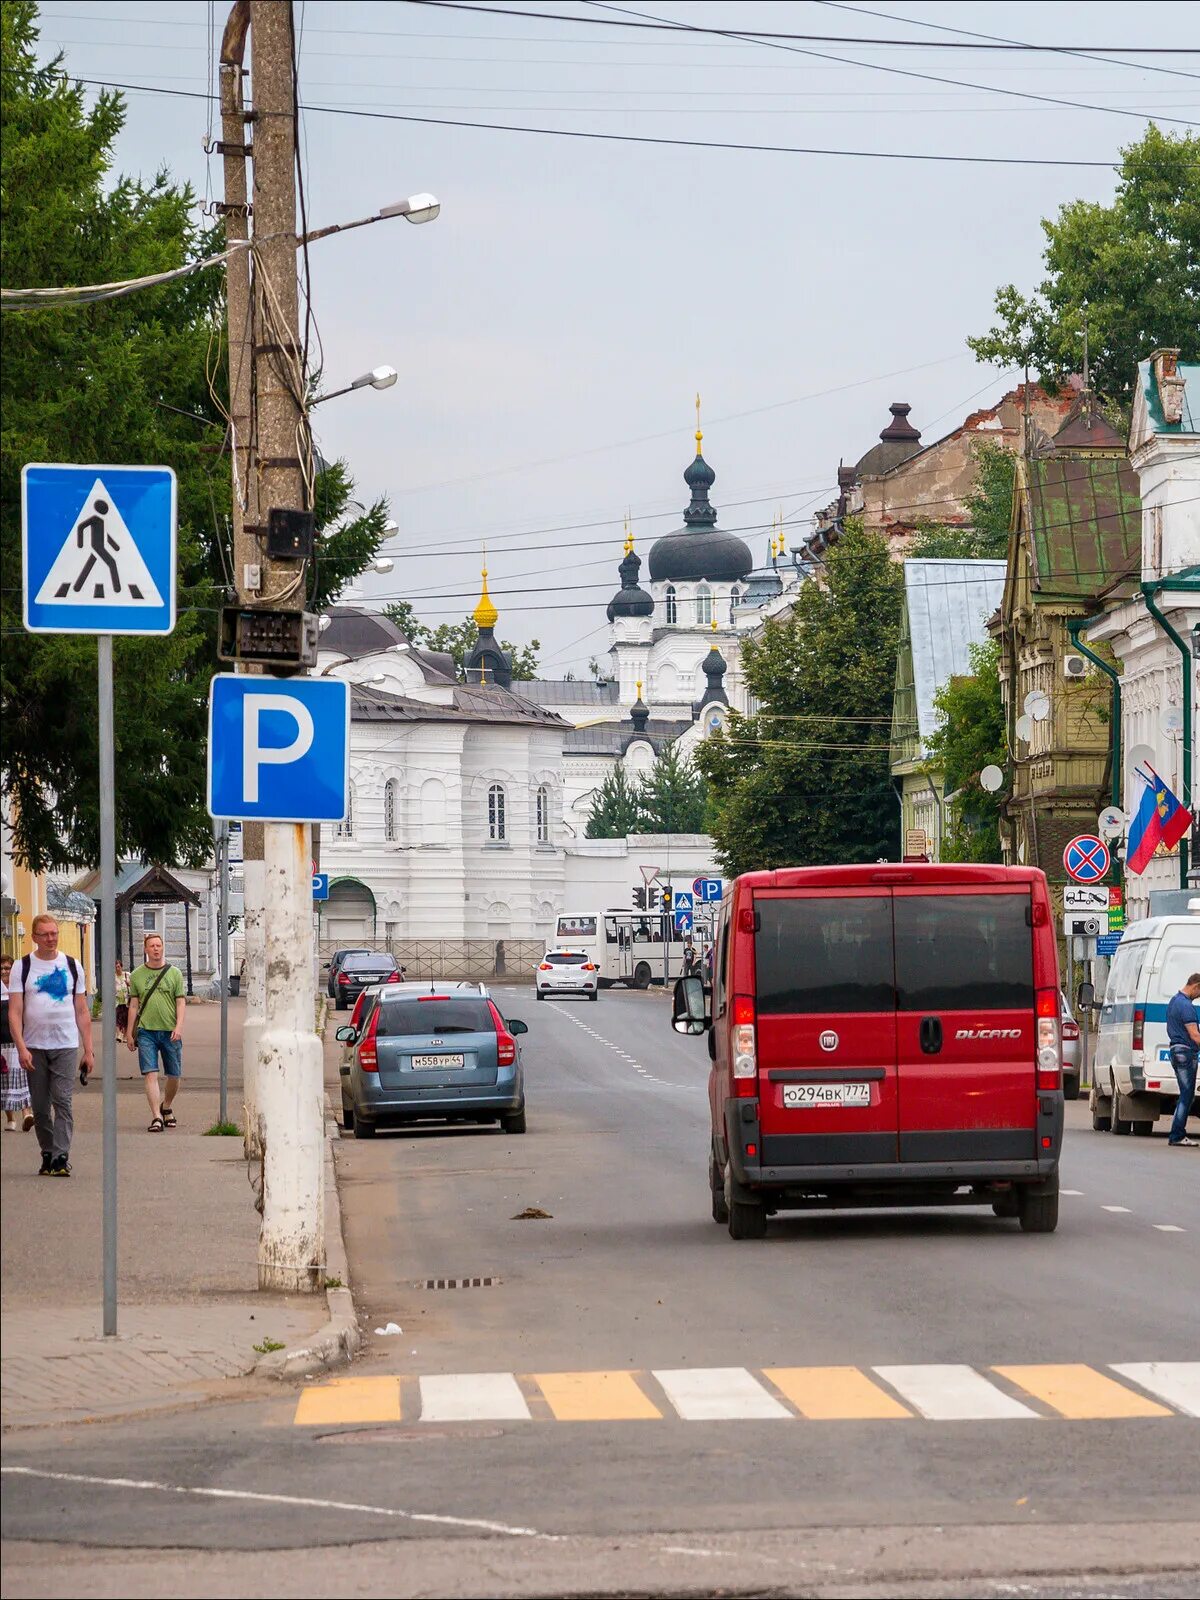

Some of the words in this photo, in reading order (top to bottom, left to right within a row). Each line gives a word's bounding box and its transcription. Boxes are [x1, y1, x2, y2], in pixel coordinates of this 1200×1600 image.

[243, 693, 315, 803] P
[954, 1029, 1022, 1040] DUCATO
[788, 1087, 842, 1101] О294ВК
[845, 1084, 865, 1096] 777
